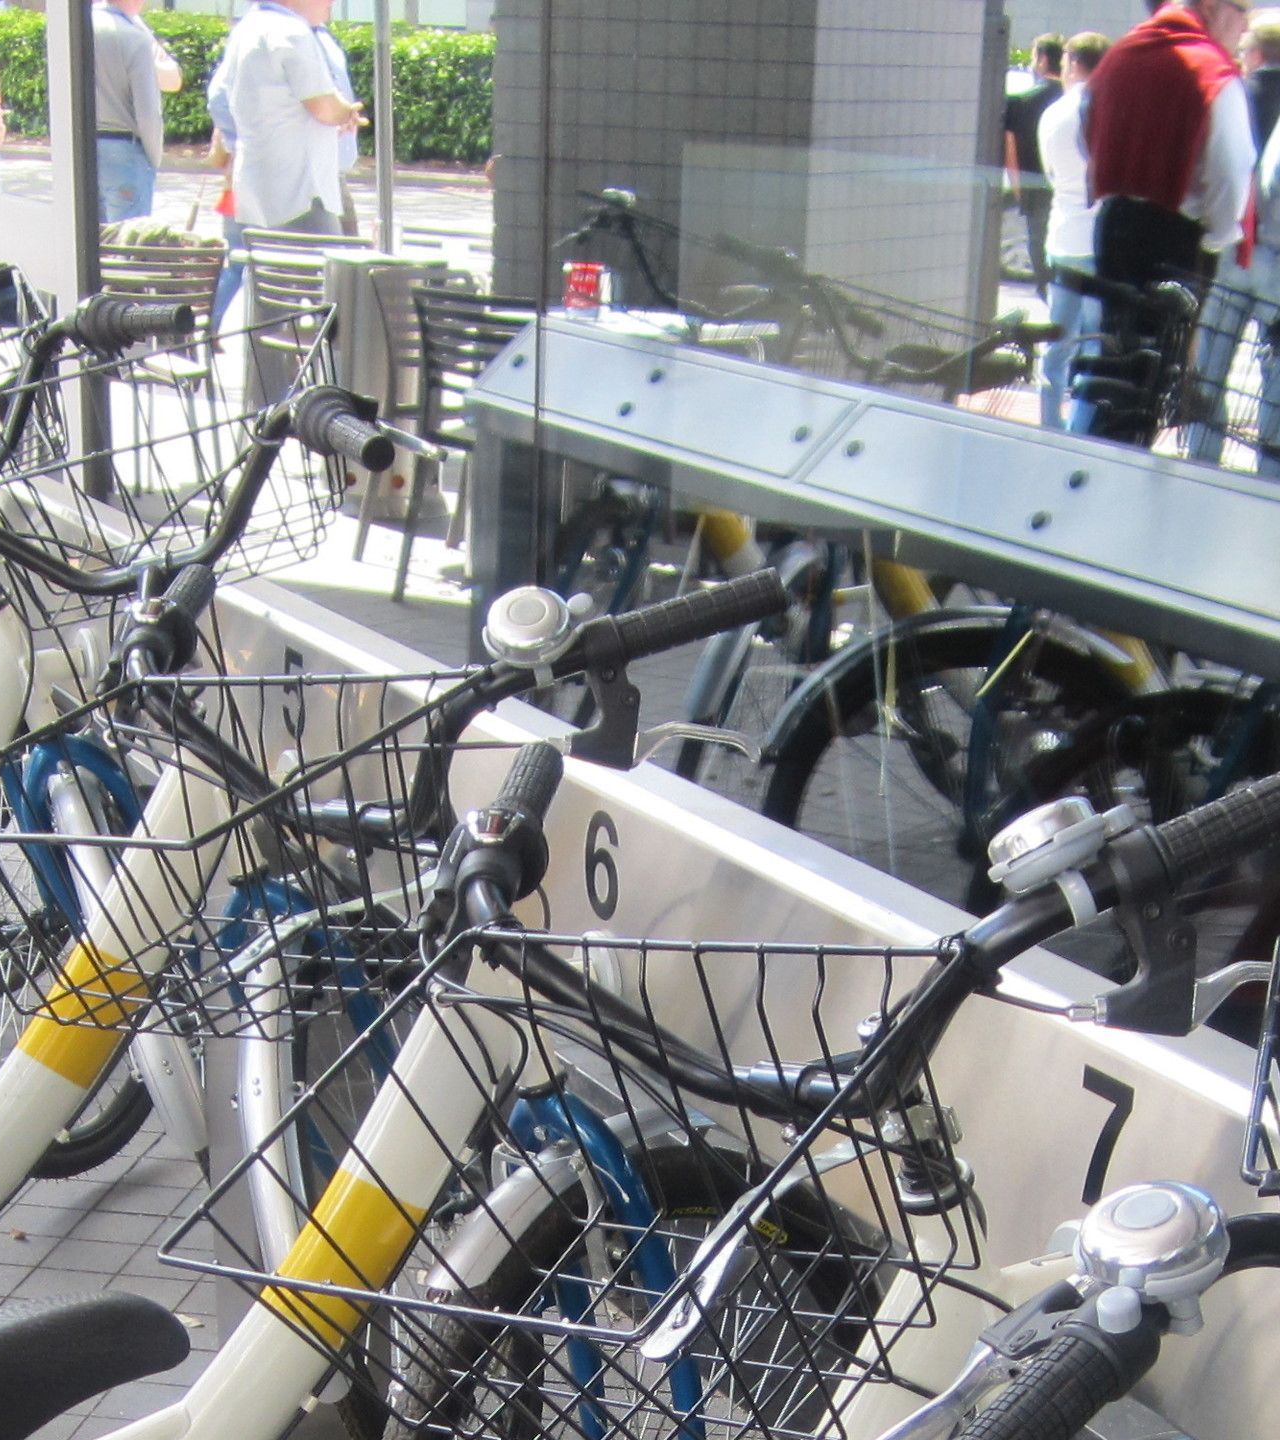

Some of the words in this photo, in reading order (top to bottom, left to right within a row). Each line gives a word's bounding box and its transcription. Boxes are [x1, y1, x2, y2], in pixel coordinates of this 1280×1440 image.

[282, 645, 308, 741] 5
[584, 809, 619, 922] 6
[1081, 1063, 1136, 1208] 7
